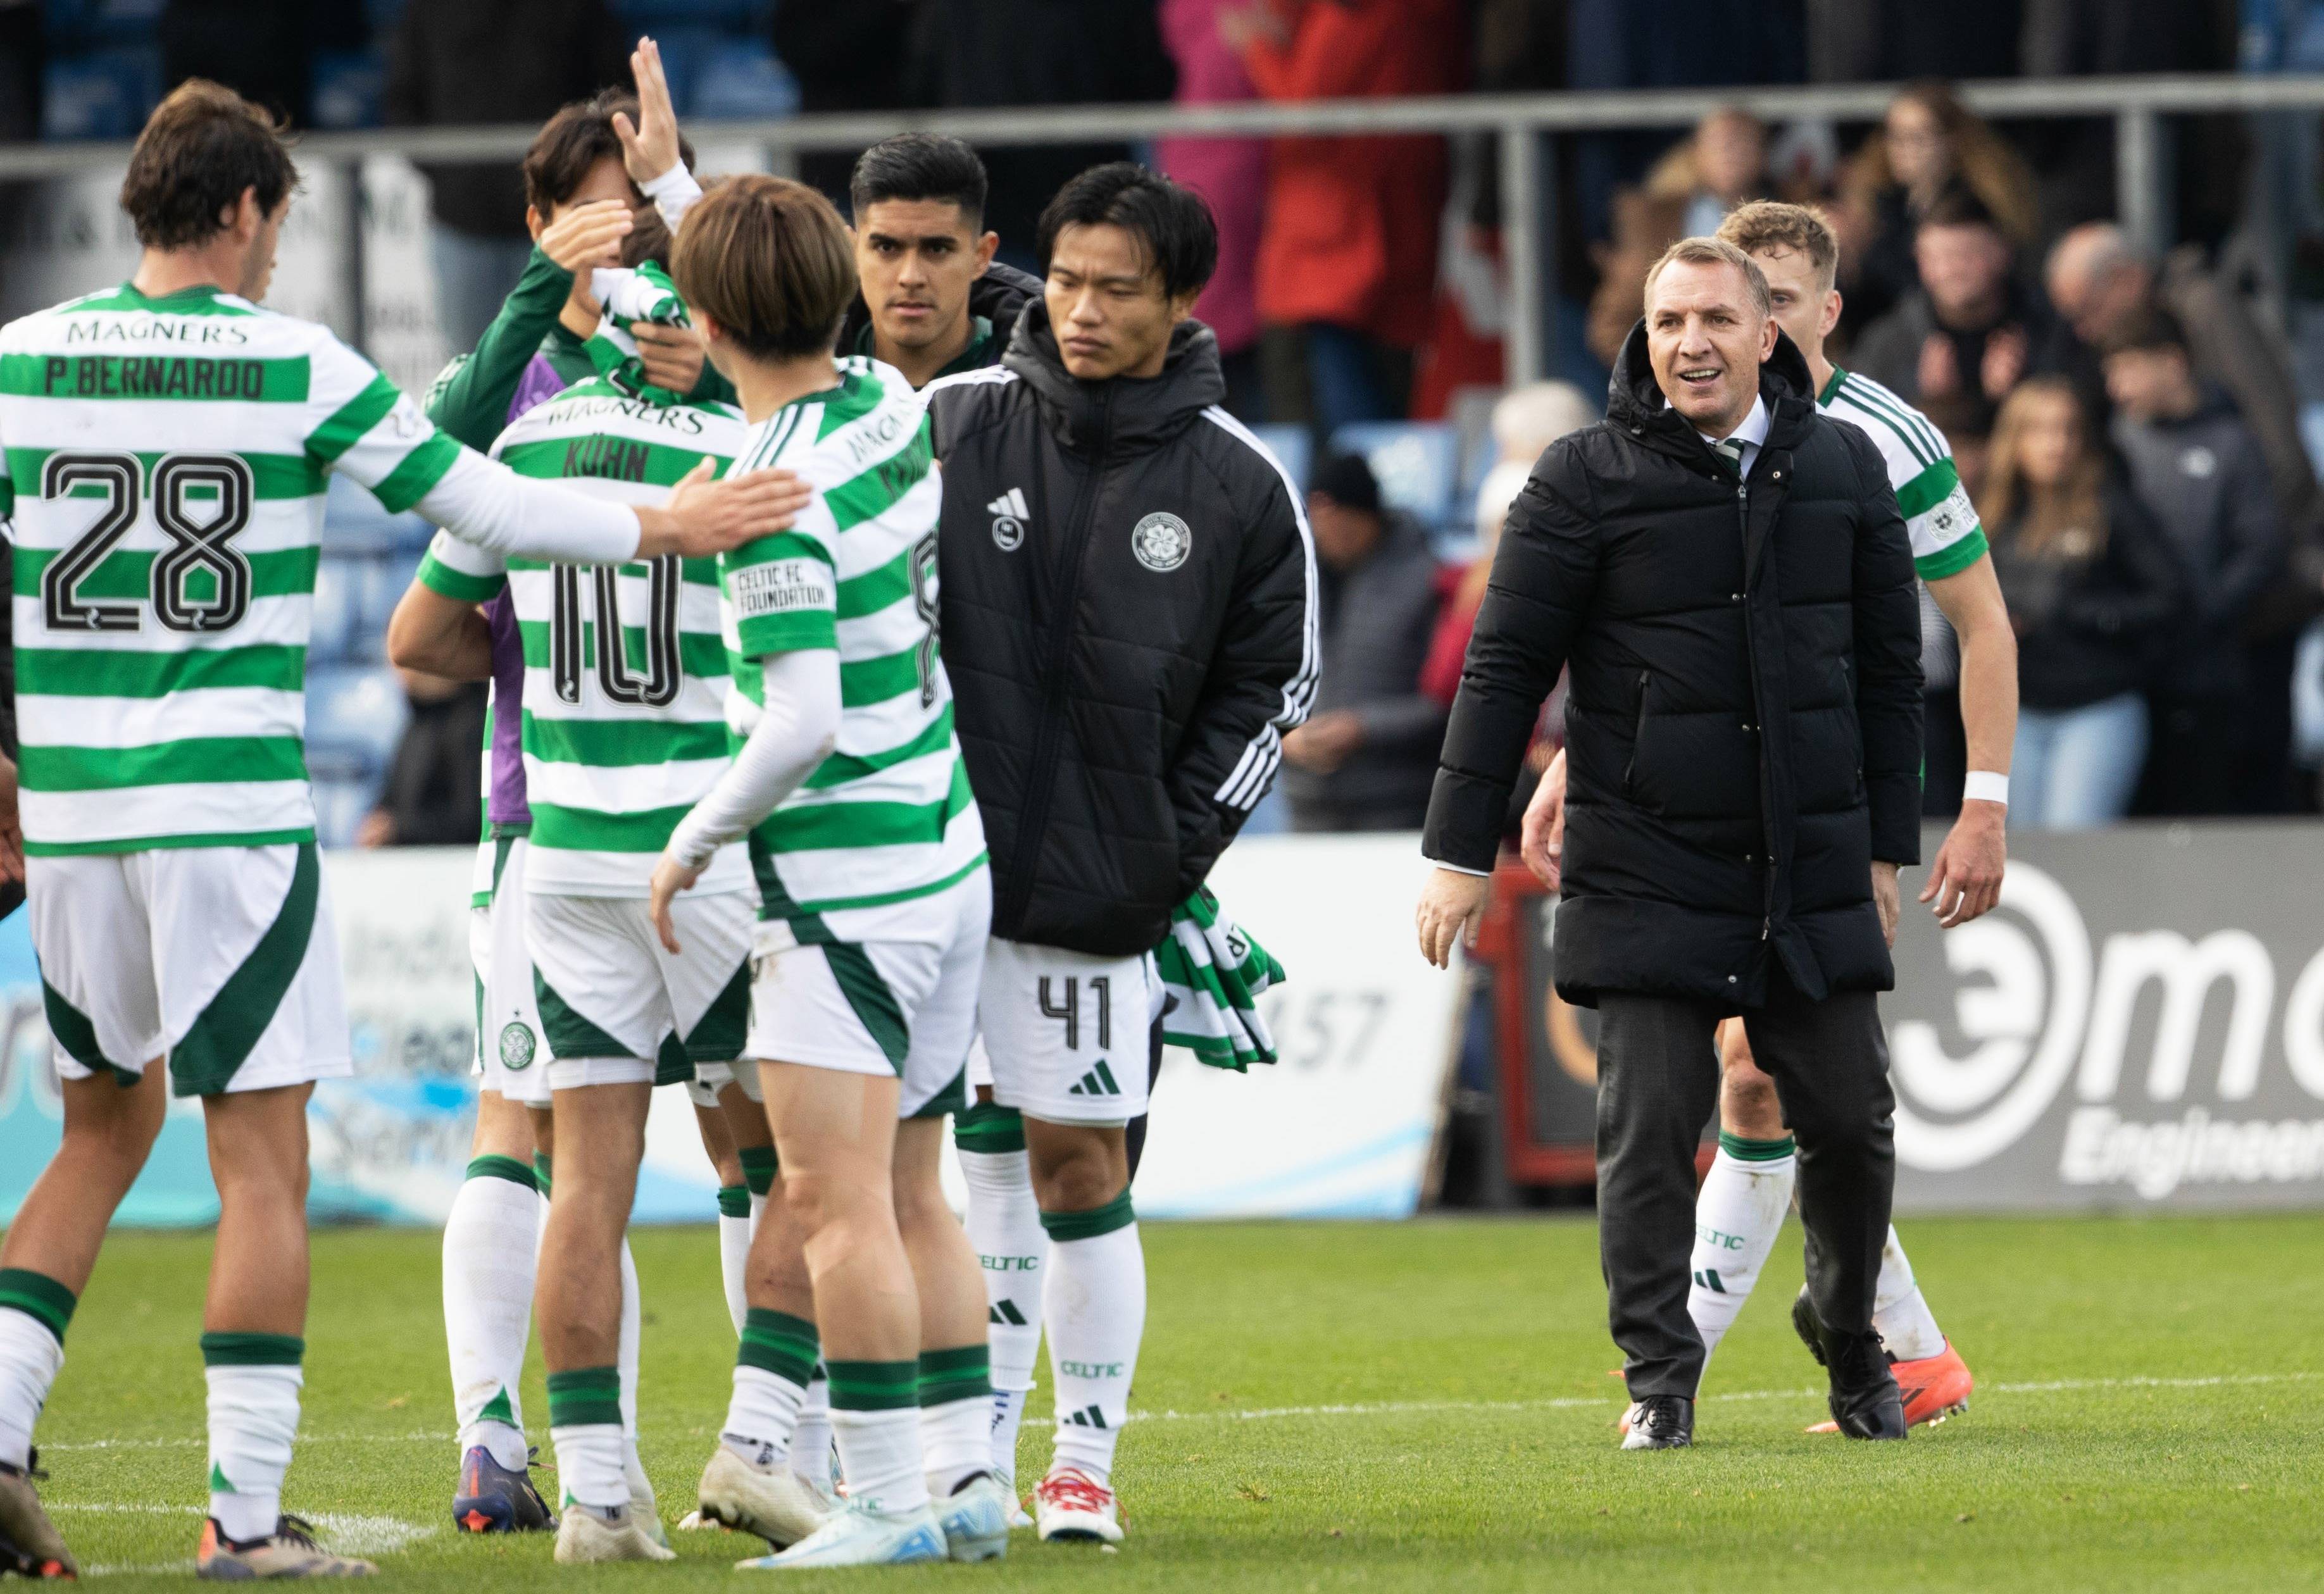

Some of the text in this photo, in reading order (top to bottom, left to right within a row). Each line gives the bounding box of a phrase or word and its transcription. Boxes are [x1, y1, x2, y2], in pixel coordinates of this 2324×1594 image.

[67, 318, 248, 346] MAGNERS
[45, 354, 264, 400] P.BERNARDO
[549, 401, 706, 435] MAGNERS
[563, 431, 651, 483] KÜHN
[41, 450, 254, 635] 28
[738, 563, 802, 591] CELTIC FC
[549, 555, 682, 708] 10
[1038, 974, 1112, 1051] 41
[1697, 1225, 1745, 1250] ELTIC
[978, 1254, 1039, 1271] ELTIC
[1059, 1359, 1124, 1379] CELTIC
